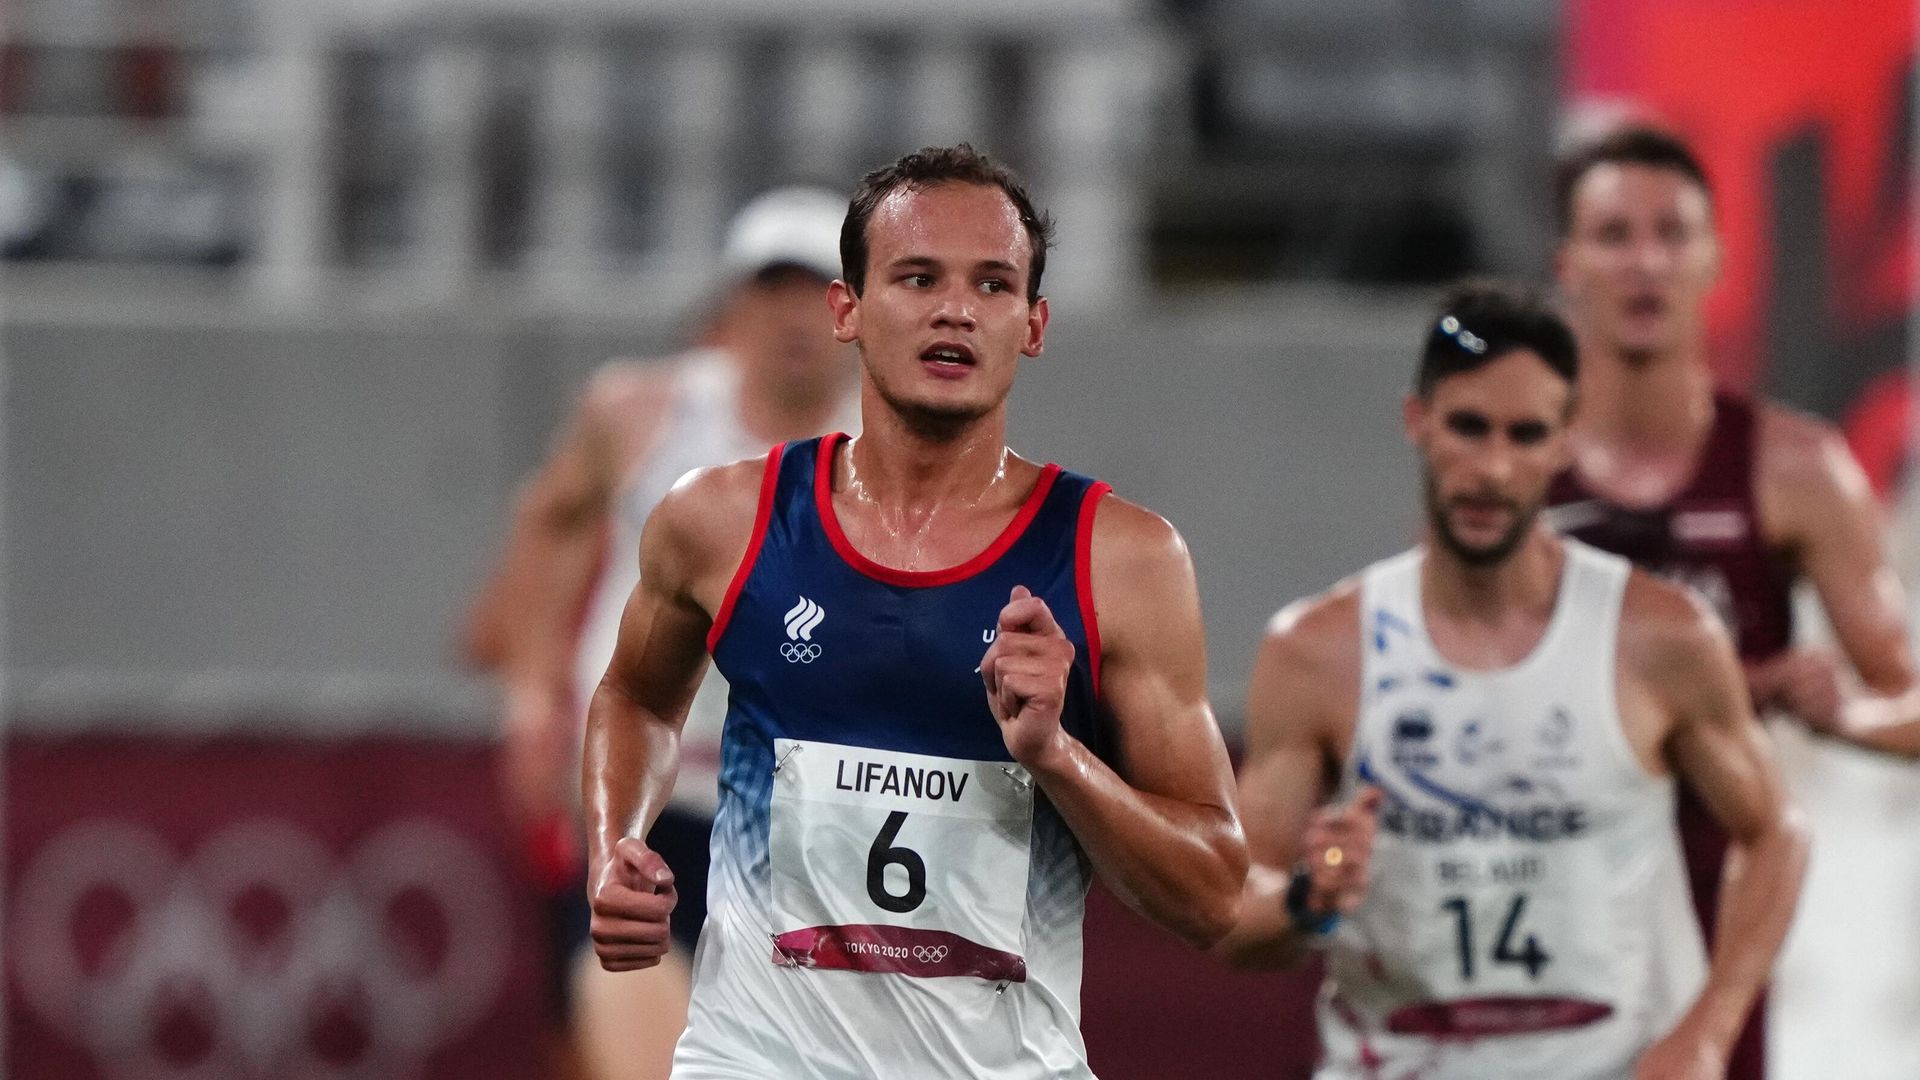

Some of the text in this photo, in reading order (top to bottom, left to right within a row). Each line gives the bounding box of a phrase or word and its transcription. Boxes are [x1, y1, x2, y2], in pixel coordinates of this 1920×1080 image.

[836, 759, 969, 802] LIFANOV
[866, 810, 927, 914] 6
[845, 942, 908, 959] TOKYO 2020
[1440, 893, 1551, 981] 14
